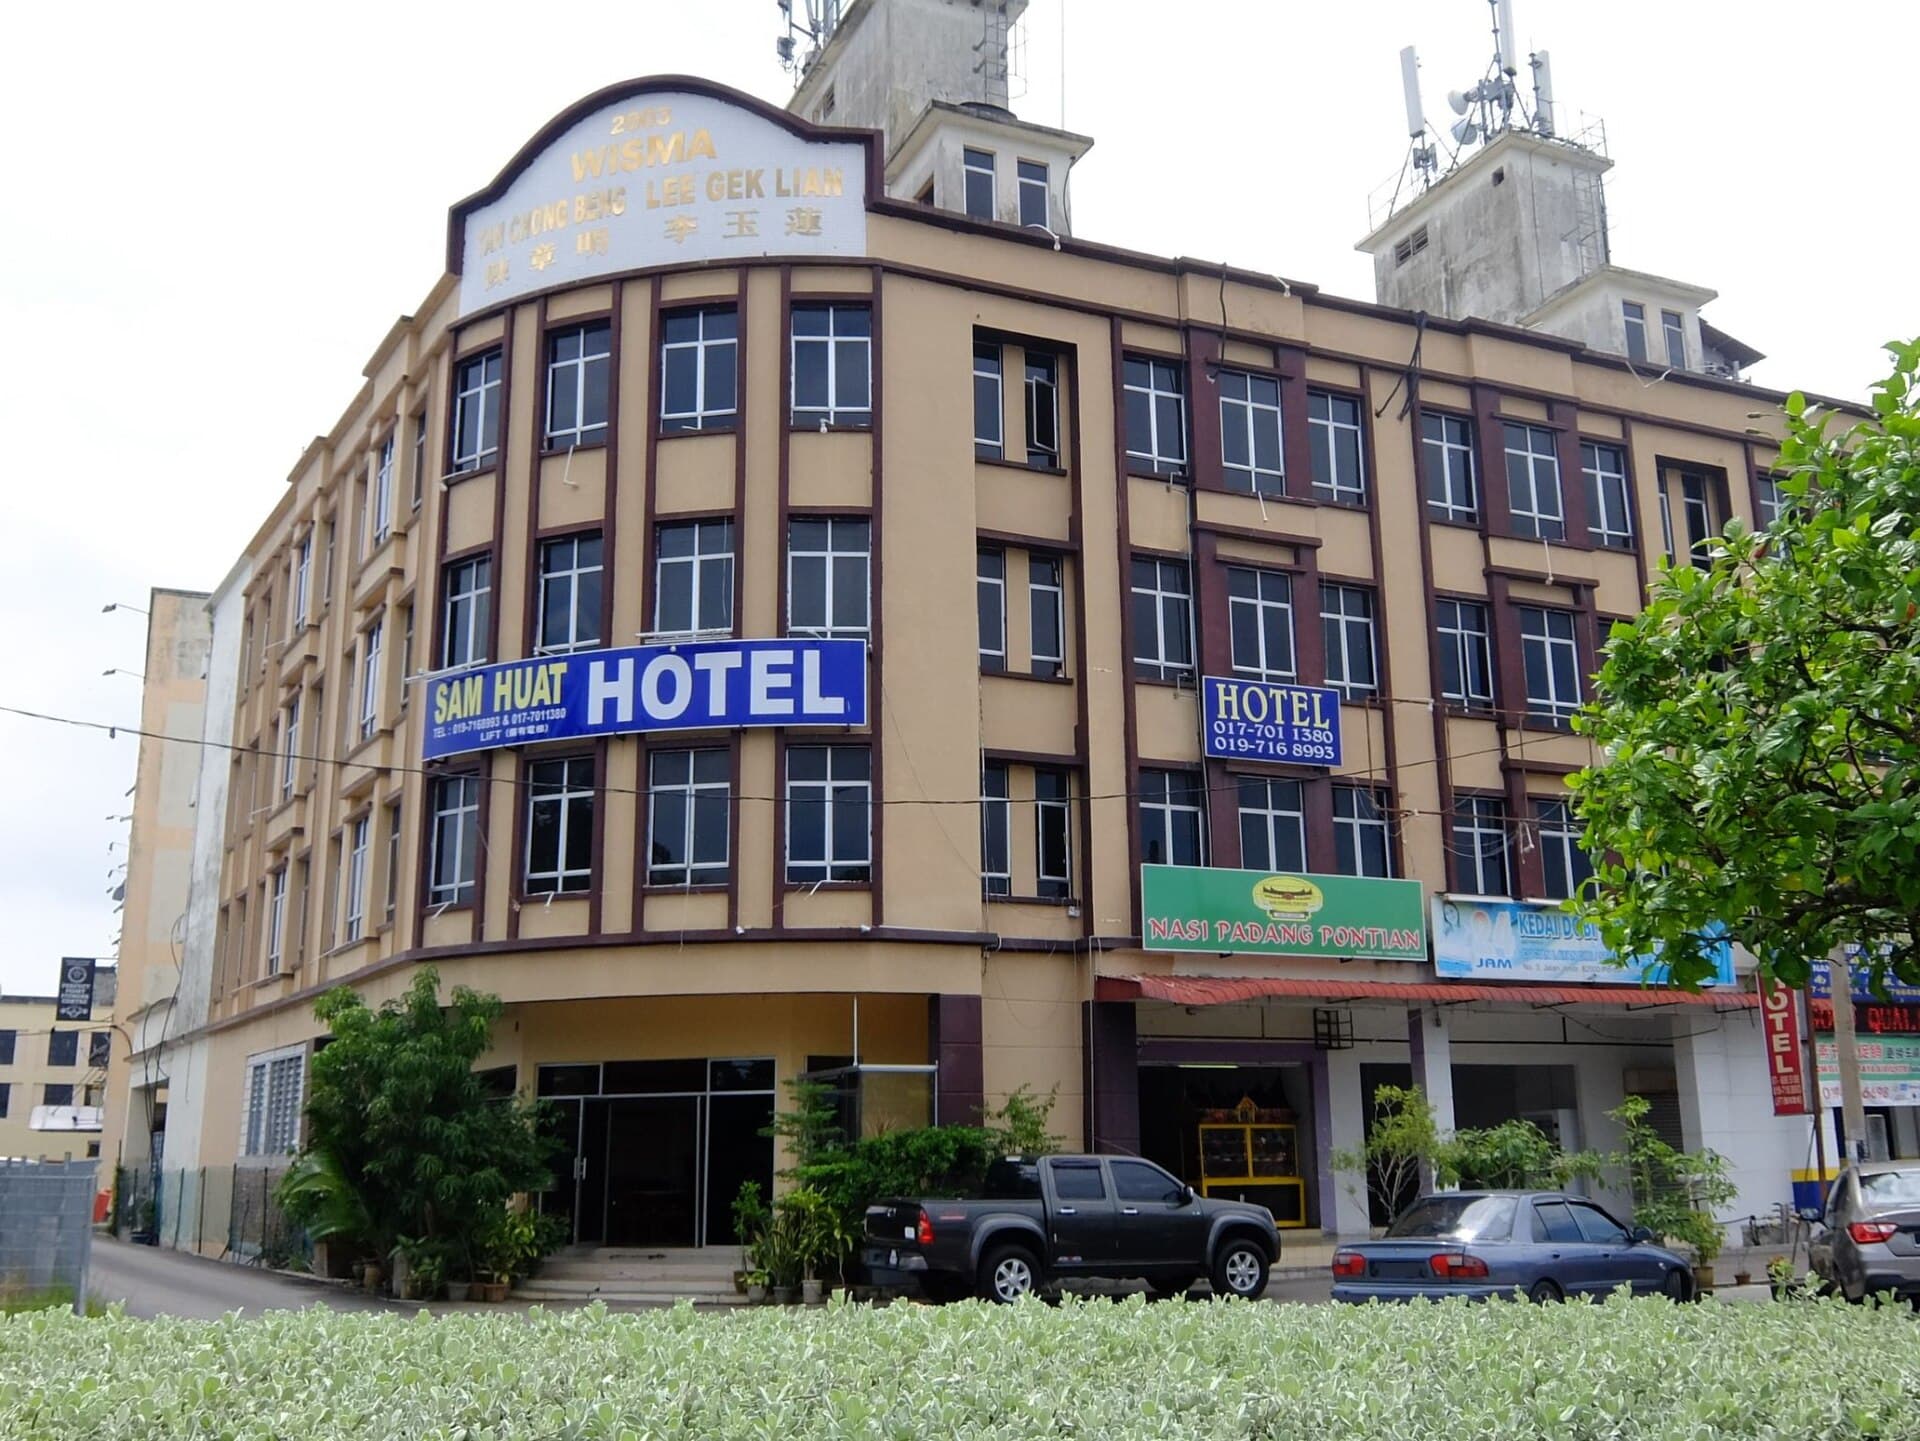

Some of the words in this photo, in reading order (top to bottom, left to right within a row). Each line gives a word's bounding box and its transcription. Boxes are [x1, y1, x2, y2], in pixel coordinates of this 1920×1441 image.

[571, 129, 717, 184] WISMA
[508, 199, 569, 243] CHONG
[573, 187, 626, 225] BENG
[646, 173, 696, 209] LEE
[706, 169, 765, 201] GEK
[775, 167, 843, 198] LIAN
[434, 675, 482, 725] SAM
[493, 661, 568, 713] HUAT
[586, 649, 846, 726] HOTEL
[502, 714, 510, 726] &
[511, 707, 567, 725] 017-7011380
[1215, 683, 1330, 730] HOTEL
[479, 729, 503, 742] LIFT
[1214, 720, 1285, 740] 017-701
[1292, 727, 1334, 744] 1380
[1214, 736, 1288, 756] 019-716
[1292, 743, 1335, 760] 8993
[1148, 916, 1210, 943] NASI
[1214, 919, 1314, 946] PADANG
[1318, 925, 1422, 951] PONTIAN
[1518, 912, 1560, 939] KEDAI
[1476, 957, 1513, 970] JAM
[1765, 977, 1794, 1074] OTEL
